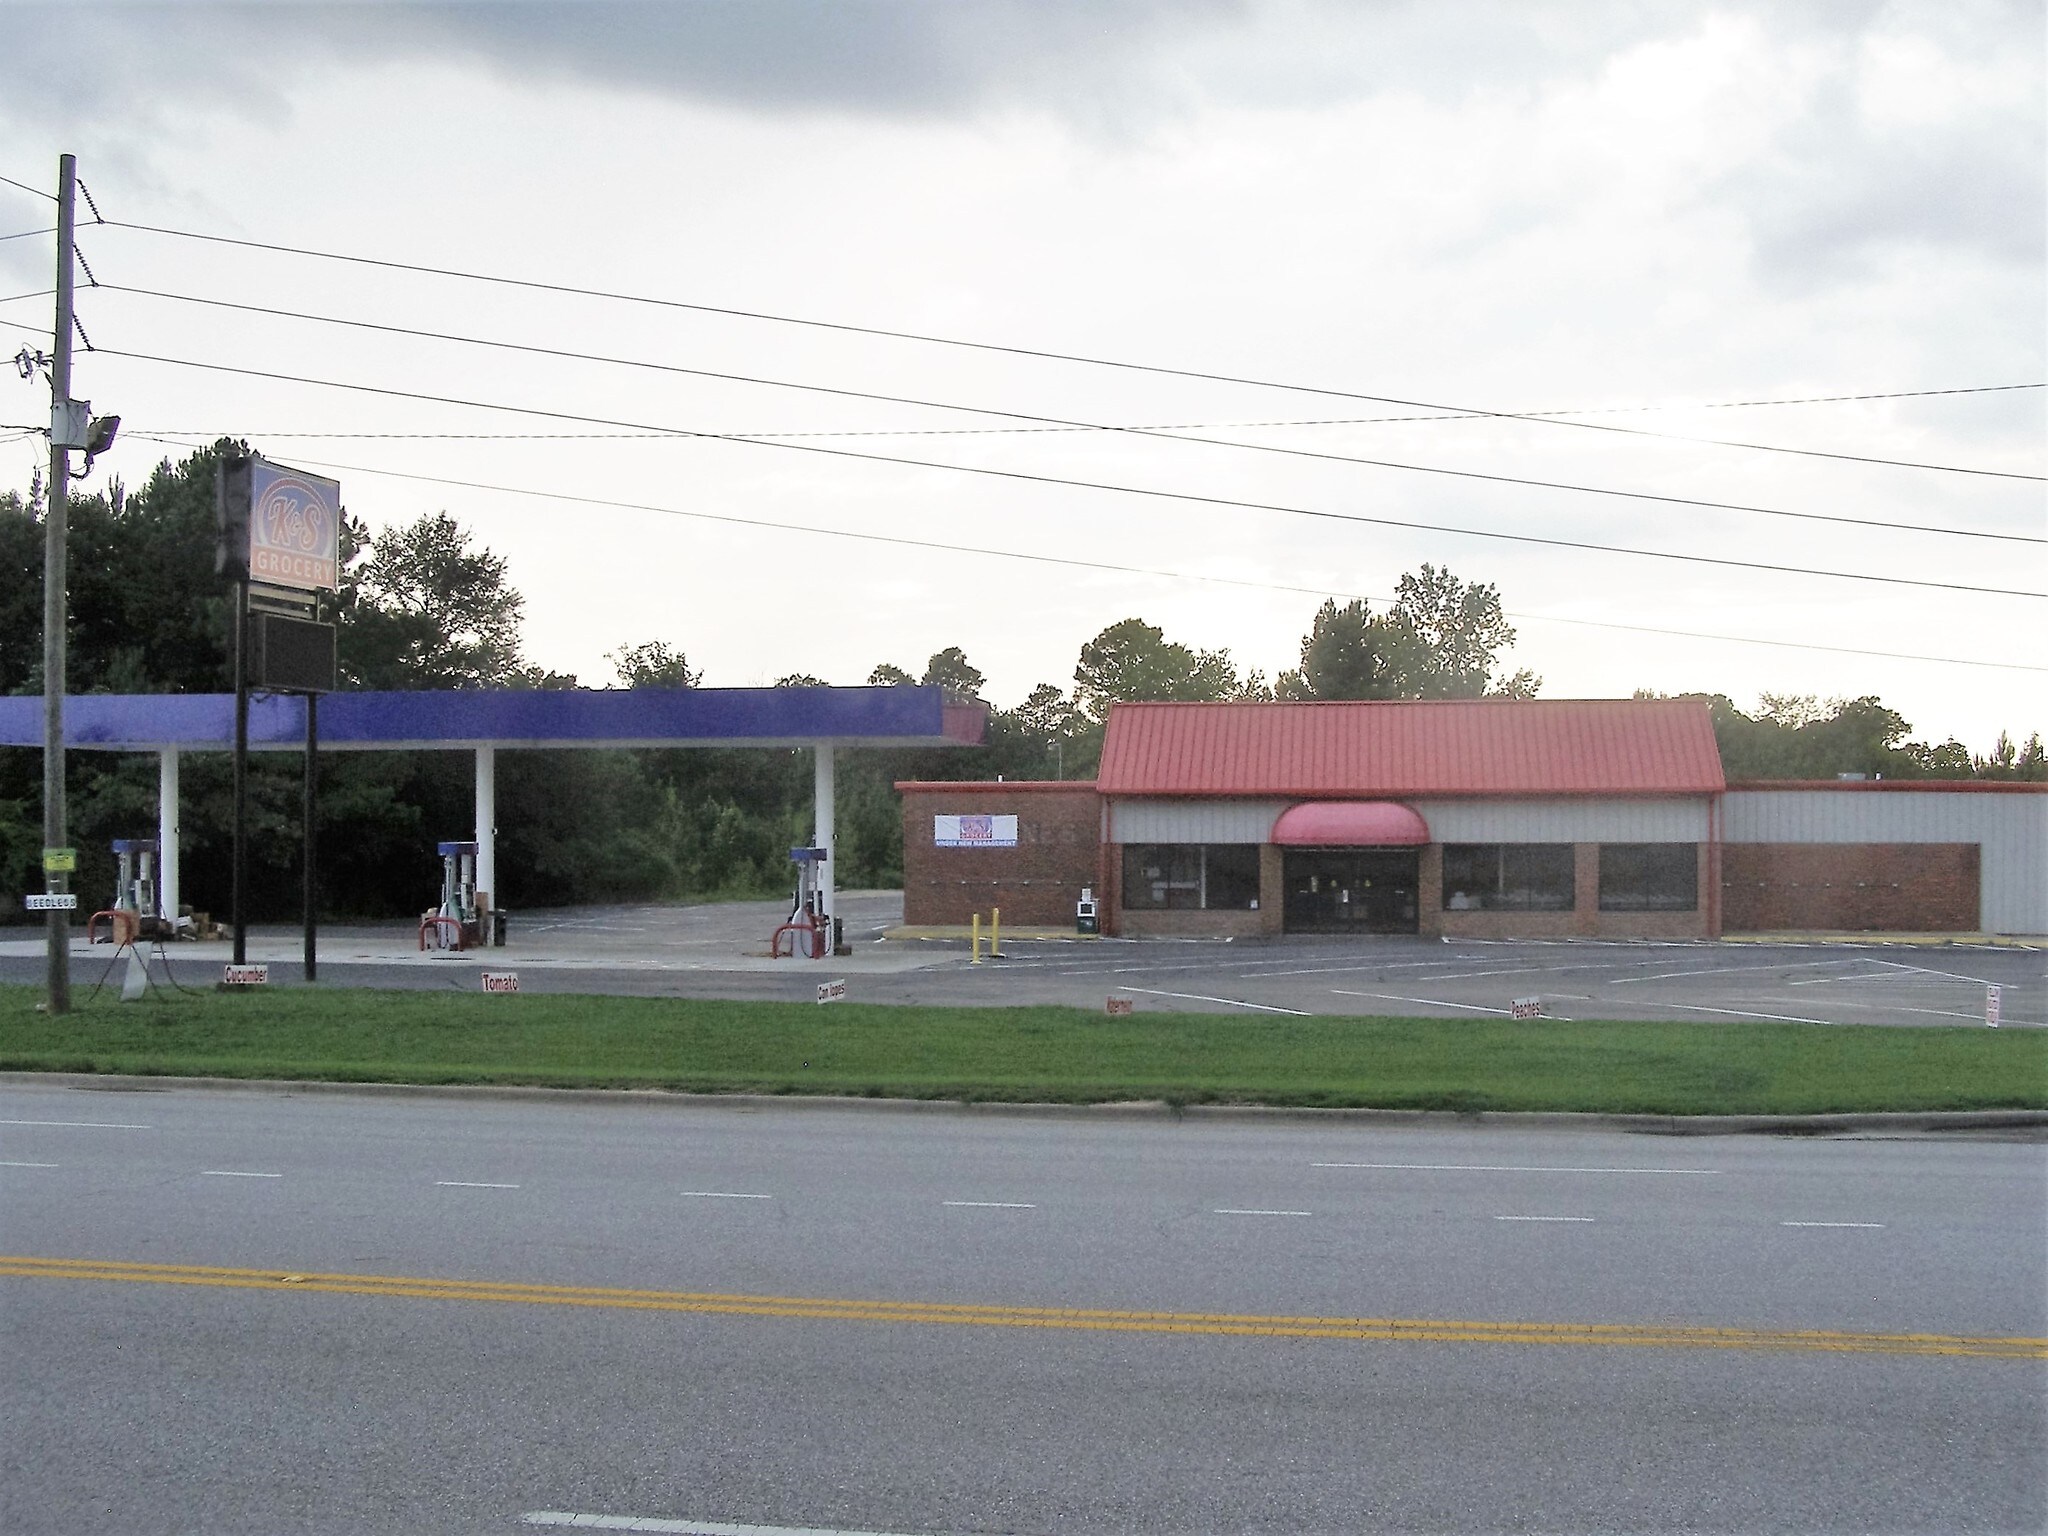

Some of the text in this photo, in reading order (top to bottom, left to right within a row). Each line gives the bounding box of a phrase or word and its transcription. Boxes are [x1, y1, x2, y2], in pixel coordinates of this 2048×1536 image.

[268, 496, 322, 550] K&S
[257, 551, 333, 580] GROCERY
[26, 898, 76, 908] SEEDLESS
[226, 966, 267, 982] Cucumber
[483, 974, 518, 991] Tomato
